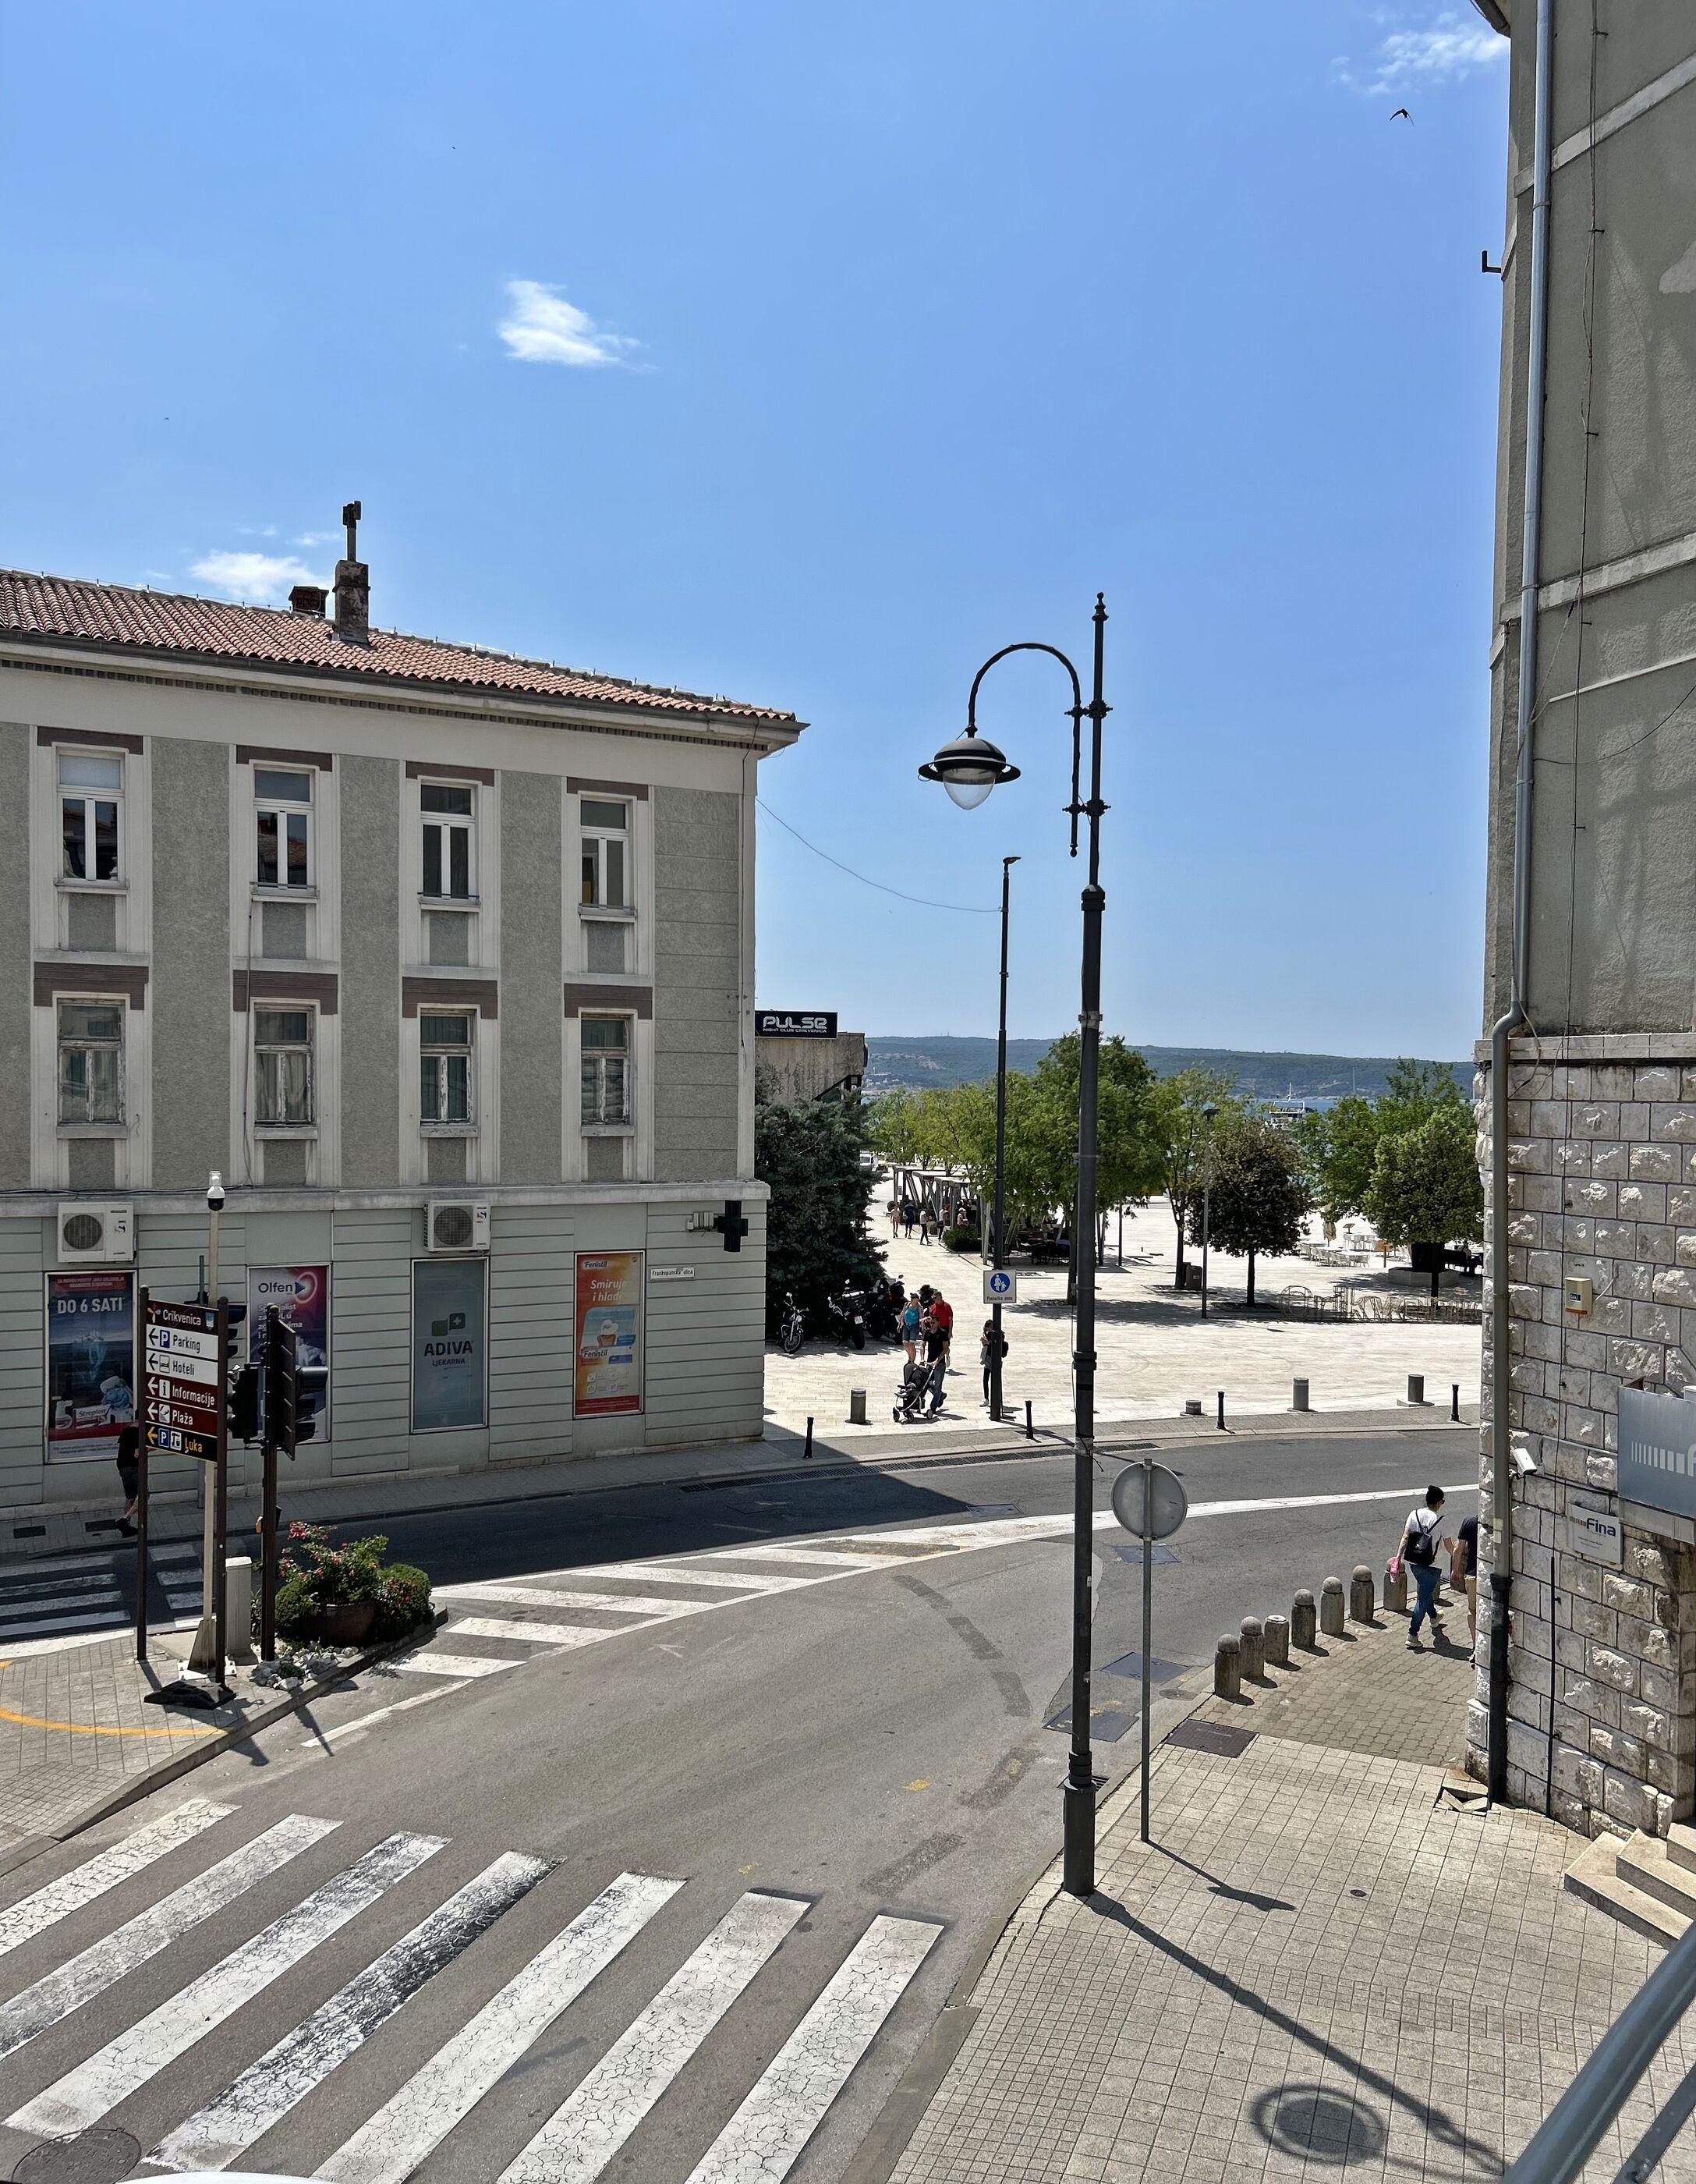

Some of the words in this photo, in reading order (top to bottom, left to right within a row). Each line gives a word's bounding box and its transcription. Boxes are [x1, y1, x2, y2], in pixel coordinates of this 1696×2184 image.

[763, 1016, 827, 1029] PULSE
[258, 1282, 292, 1293] Olfen
[590, 1278, 627, 1290] Smiruje
[593, 1292, 597, 1302] i
[598, 1291, 622, 1302] hladi
[57, 1299, 76, 1314] DO
[80, 1299, 88, 1313] 6
[91, 1297, 122, 1312] SATI
[162, 1309, 201, 1325] Crikvenica
[161, 1331, 168, 1346] P
[173, 1335, 200, 1353] Parking
[423, 1340, 473, 1356] ADIVA
[172, 1360, 195, 1375] Hoteli
[432, 1358, 466, 1367] LJEKARNA
[172, 1384, 215, 1408] Informacije
[172, 1409, 193, 1425] Plaža
[161, 1431, 167, 1444] P
[185, 1437, 203, 1452] Luka
[1586, 1517, 1616, 1537] Fina
